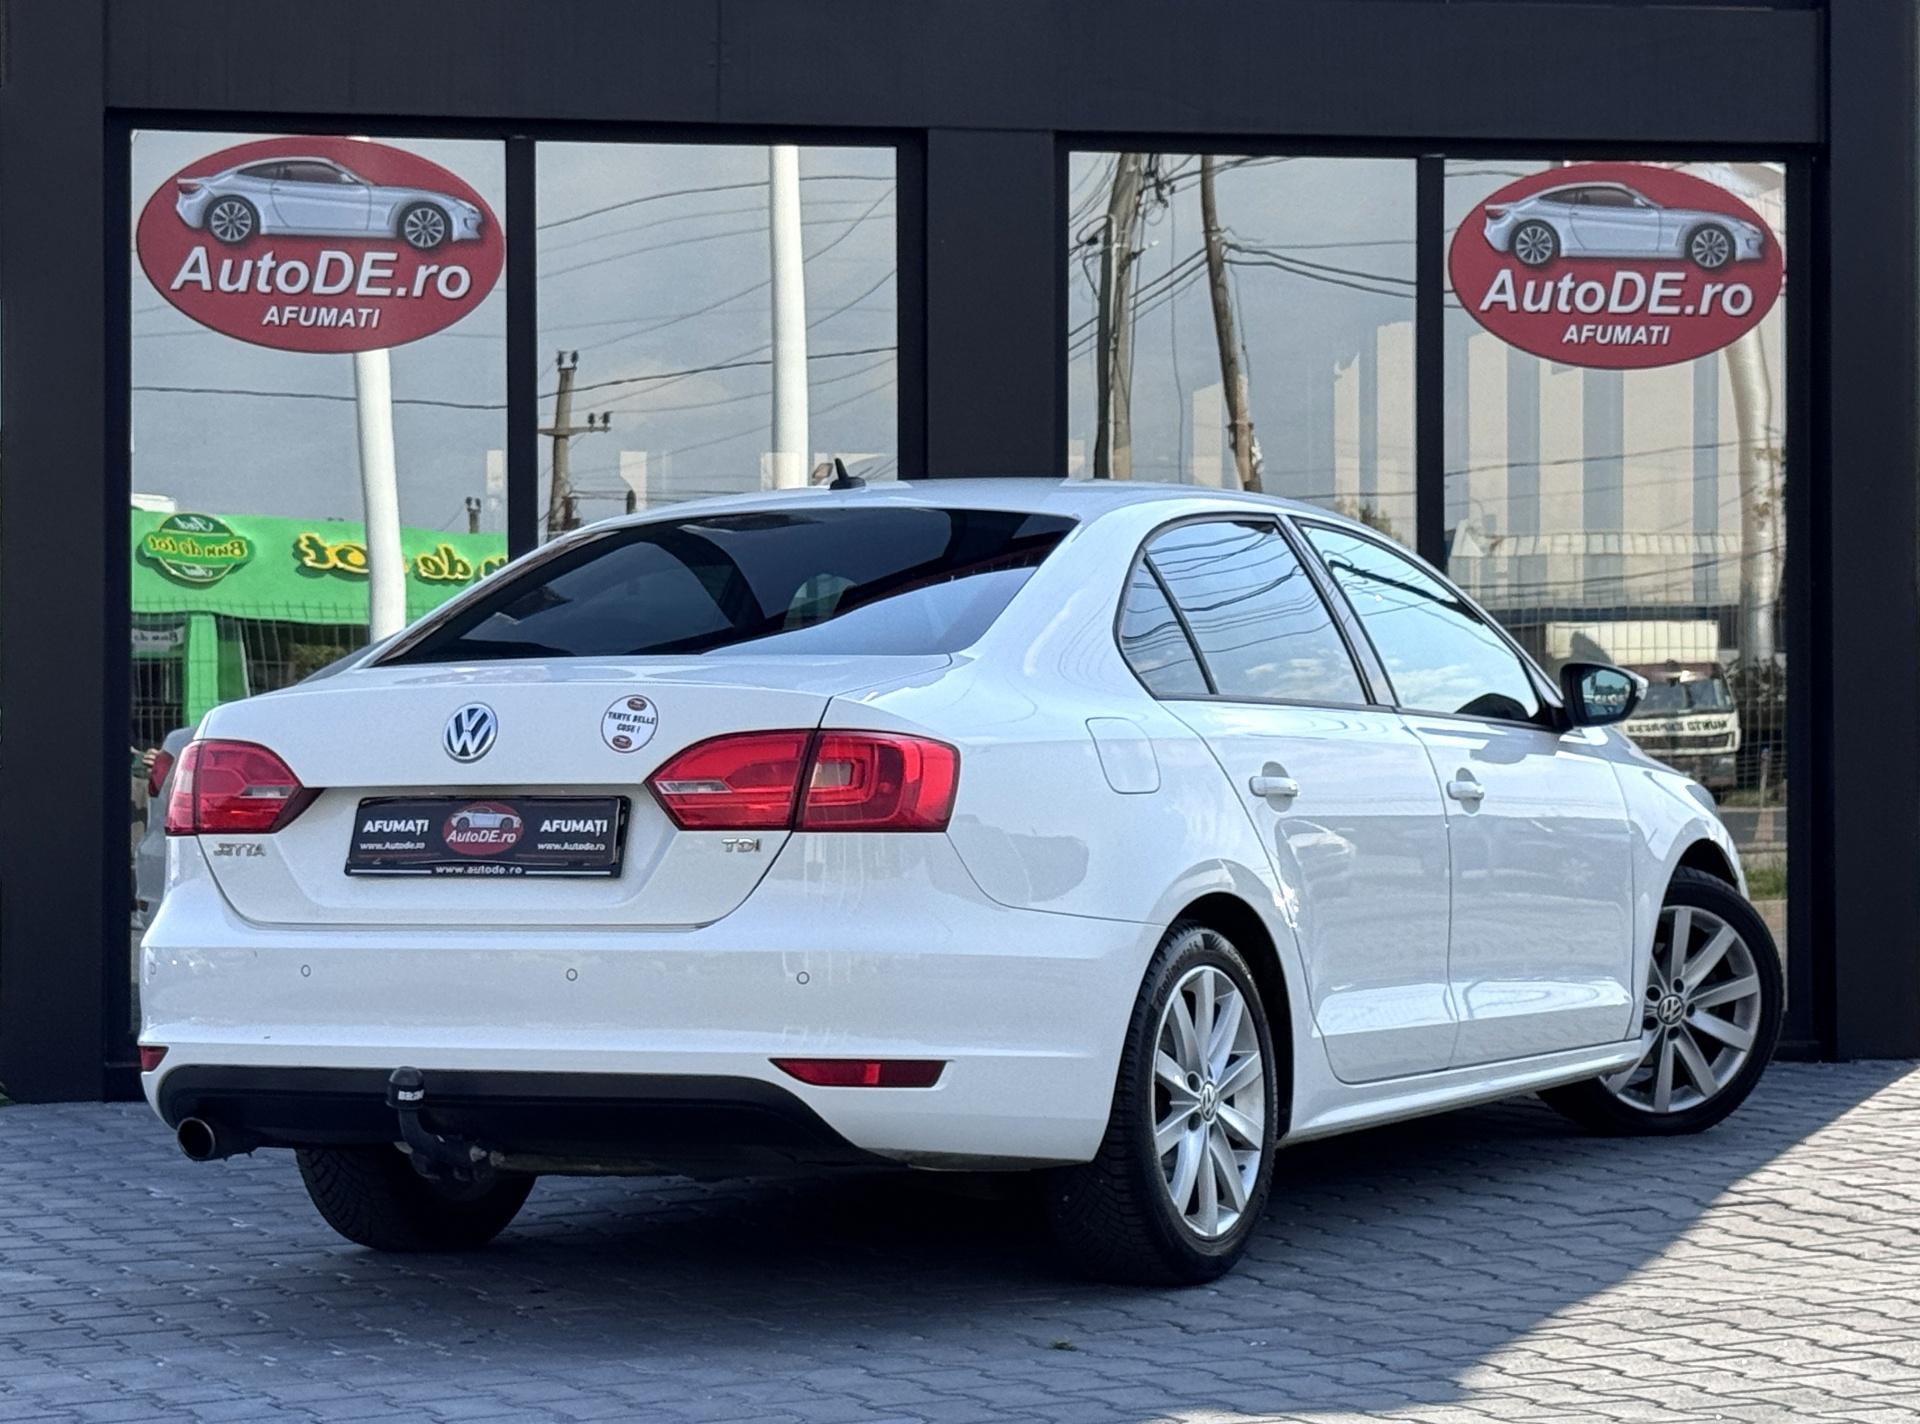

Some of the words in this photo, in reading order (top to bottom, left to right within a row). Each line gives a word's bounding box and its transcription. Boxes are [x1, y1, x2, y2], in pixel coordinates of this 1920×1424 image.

[171, 246, 472, 299] AutoDE.ro
[1480, 268, 1754, 316] AutoDE.ro
[262, 306, 380, 329] AFUMATI
[1562, 324, 1671, 346] AFUMATI
[446, 829, 517, 843] AutoDE.ro
[213, 842, 266, 856] JETTA
[721, 838, 762, 853] TDI
[435, 864, 523, 875] www.autode.ro
